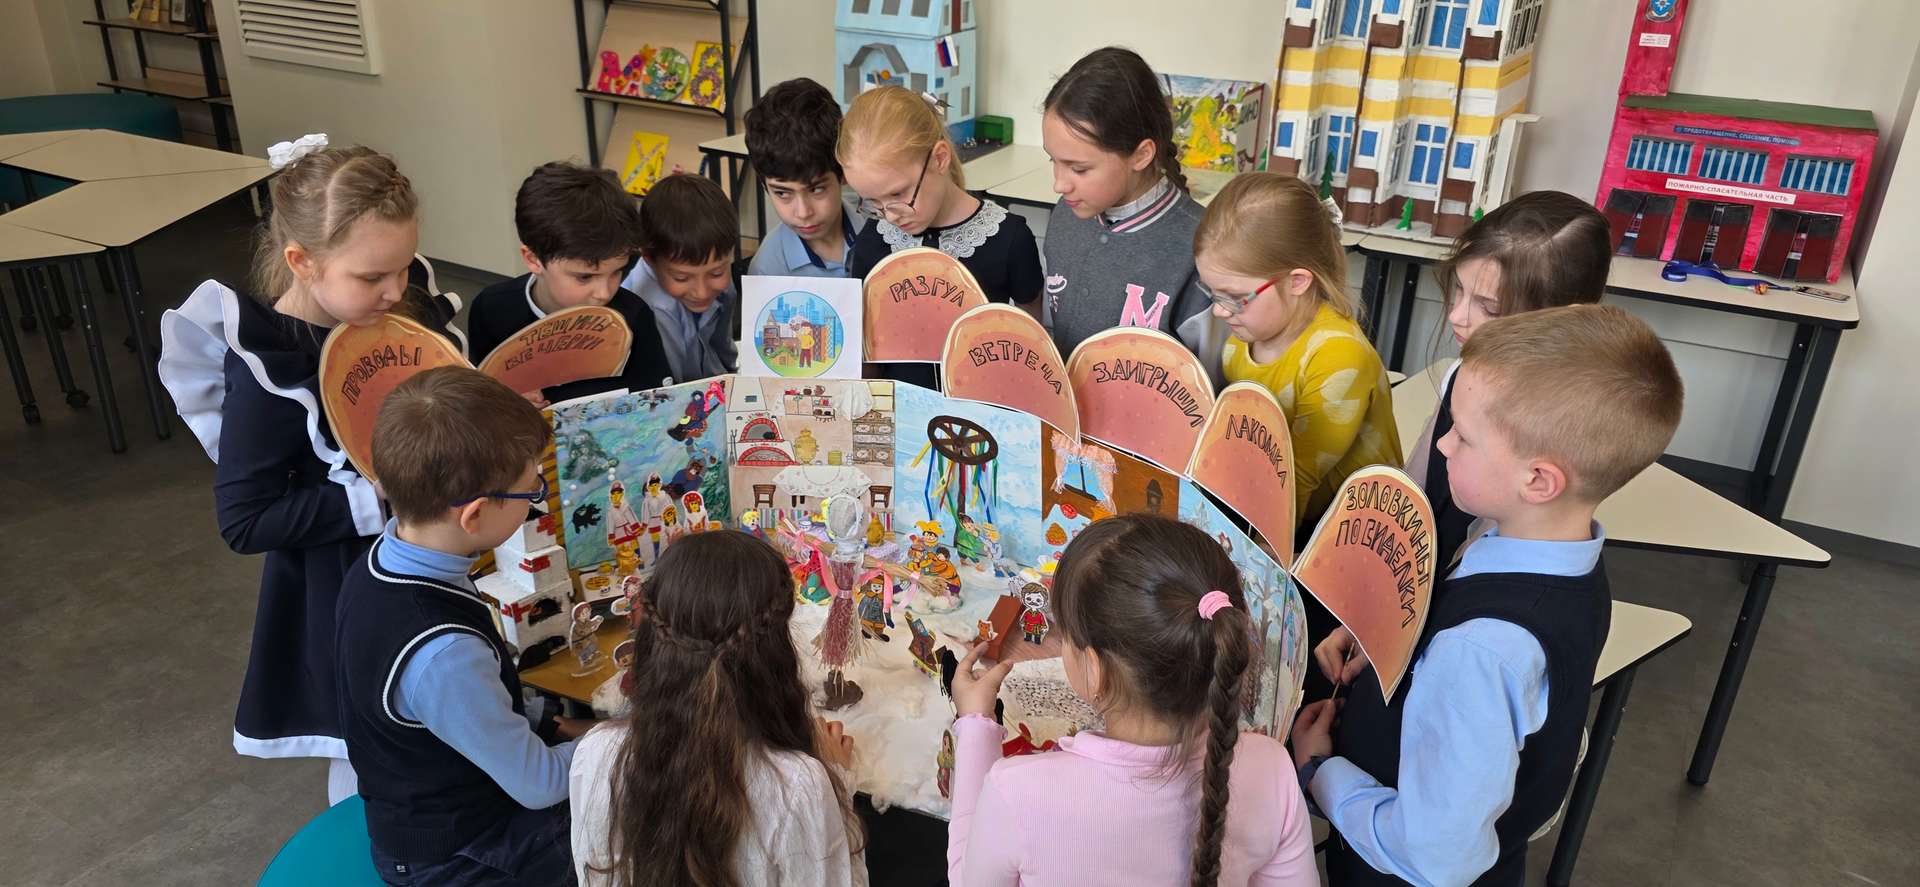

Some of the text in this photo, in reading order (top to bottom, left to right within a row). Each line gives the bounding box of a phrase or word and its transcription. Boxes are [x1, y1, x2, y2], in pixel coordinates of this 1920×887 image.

[1667, 181, 1789, 202] ПОЖАРНО-СПАСАТЕЛЬНАЯ ЧАСТЬ
[890, 275, 967, 308] РАЗГУЛ
[519, 314, 613, 346] ТЕЩИНЫ
[341, 344, 422, 406] ПРОВОДЫ
[968, 340, 1063, 394] ВСТРЕЧА
[1093, 358, 1205, 428] ЗАИГРЫШИ
[1226, 414, 1287, 489] ЛАКОМКА
[1346, 481, 1430, 587] ЗОЛОВКИНЫ
